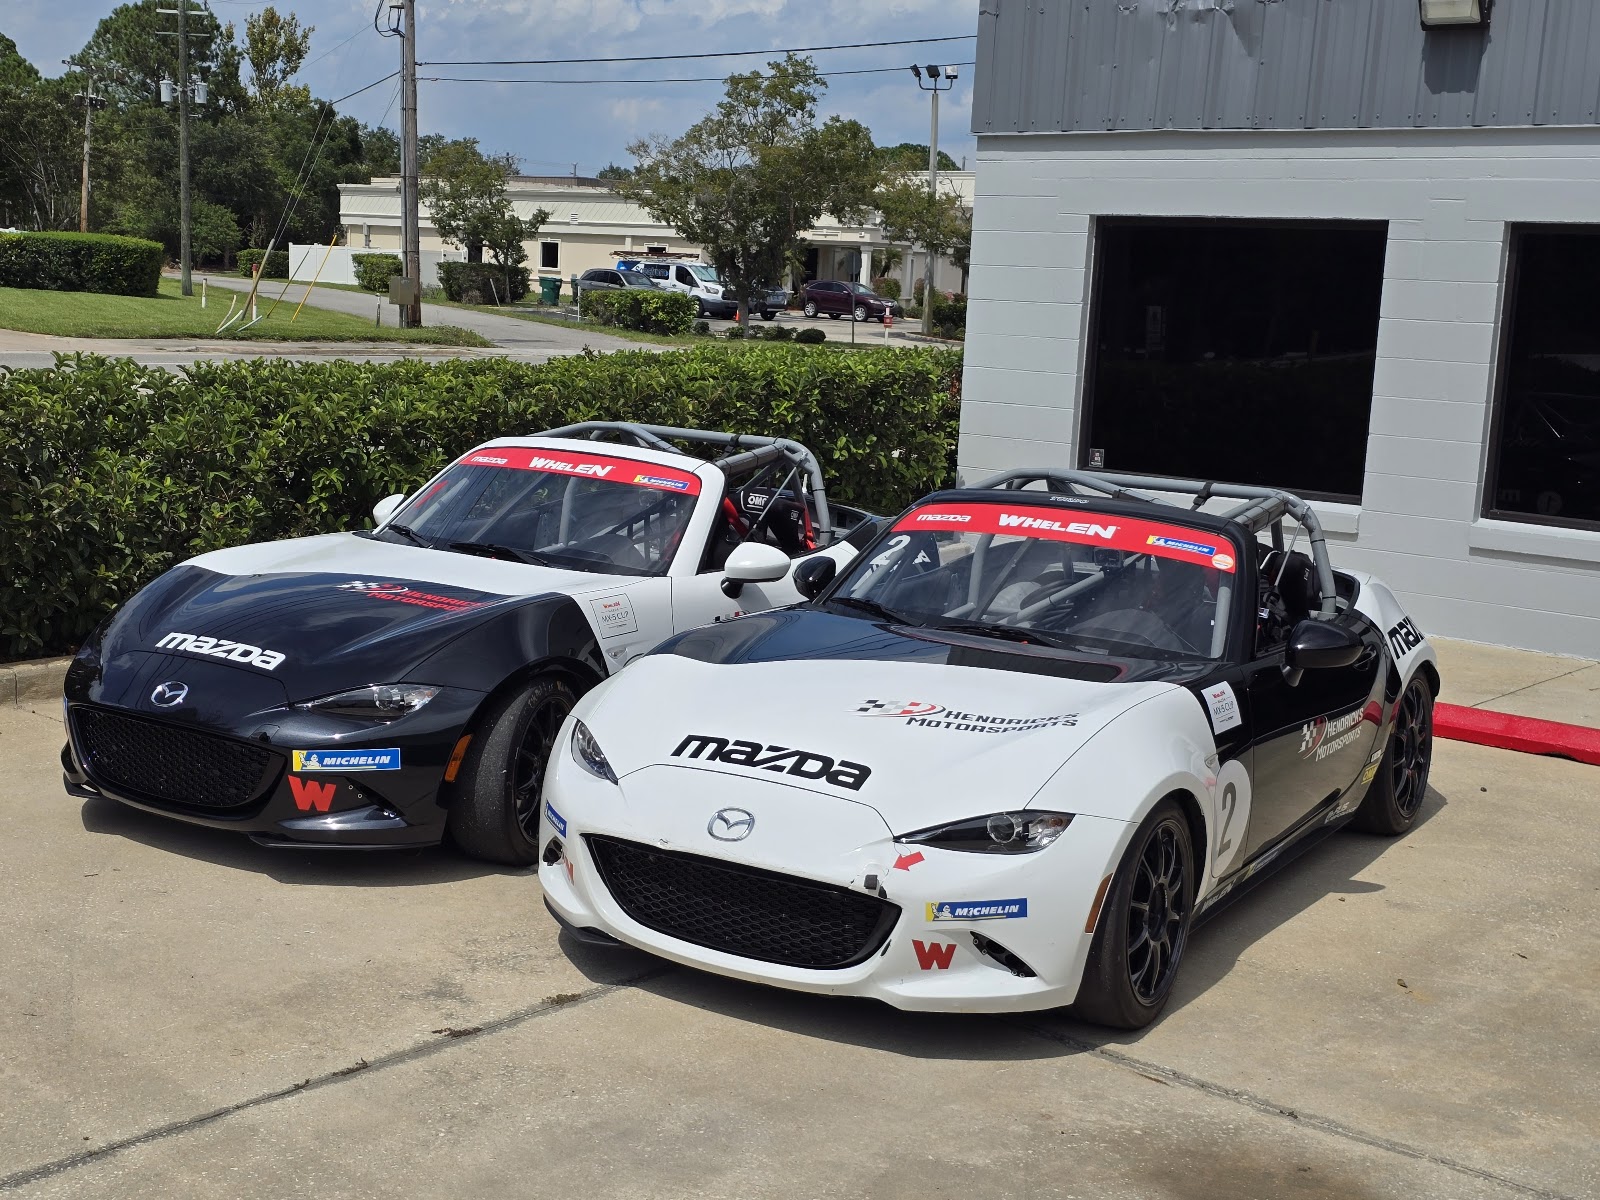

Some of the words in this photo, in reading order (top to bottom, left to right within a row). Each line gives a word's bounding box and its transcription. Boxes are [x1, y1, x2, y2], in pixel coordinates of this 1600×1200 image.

[529, 456, 612, 477] WHELEN
[916, 514, 972, 523] mazda
[998, 513, 1116, 539] WHELEN
[1166, 540, 1210, 553] MICHELIN
[155, 632, 286, 671] mazda
[905, 717, 1079, 734] MOTORSPORTS
[944, 710, 1080, 725] HENDRICKS
[1327, 707, 1364, 738] HENDRICKS
[1316, 726, 1362, 762] MOTORSPORTS
[323, 755, 391, 765] MICHELIN
[670, 734, 872, 791] mazda
[288, 774, 336, 812] W
[1218, 781, 1237, 858] 2
[955, 905, 1020, 916] MICHELIN
[911, 939, 957, 970] W
